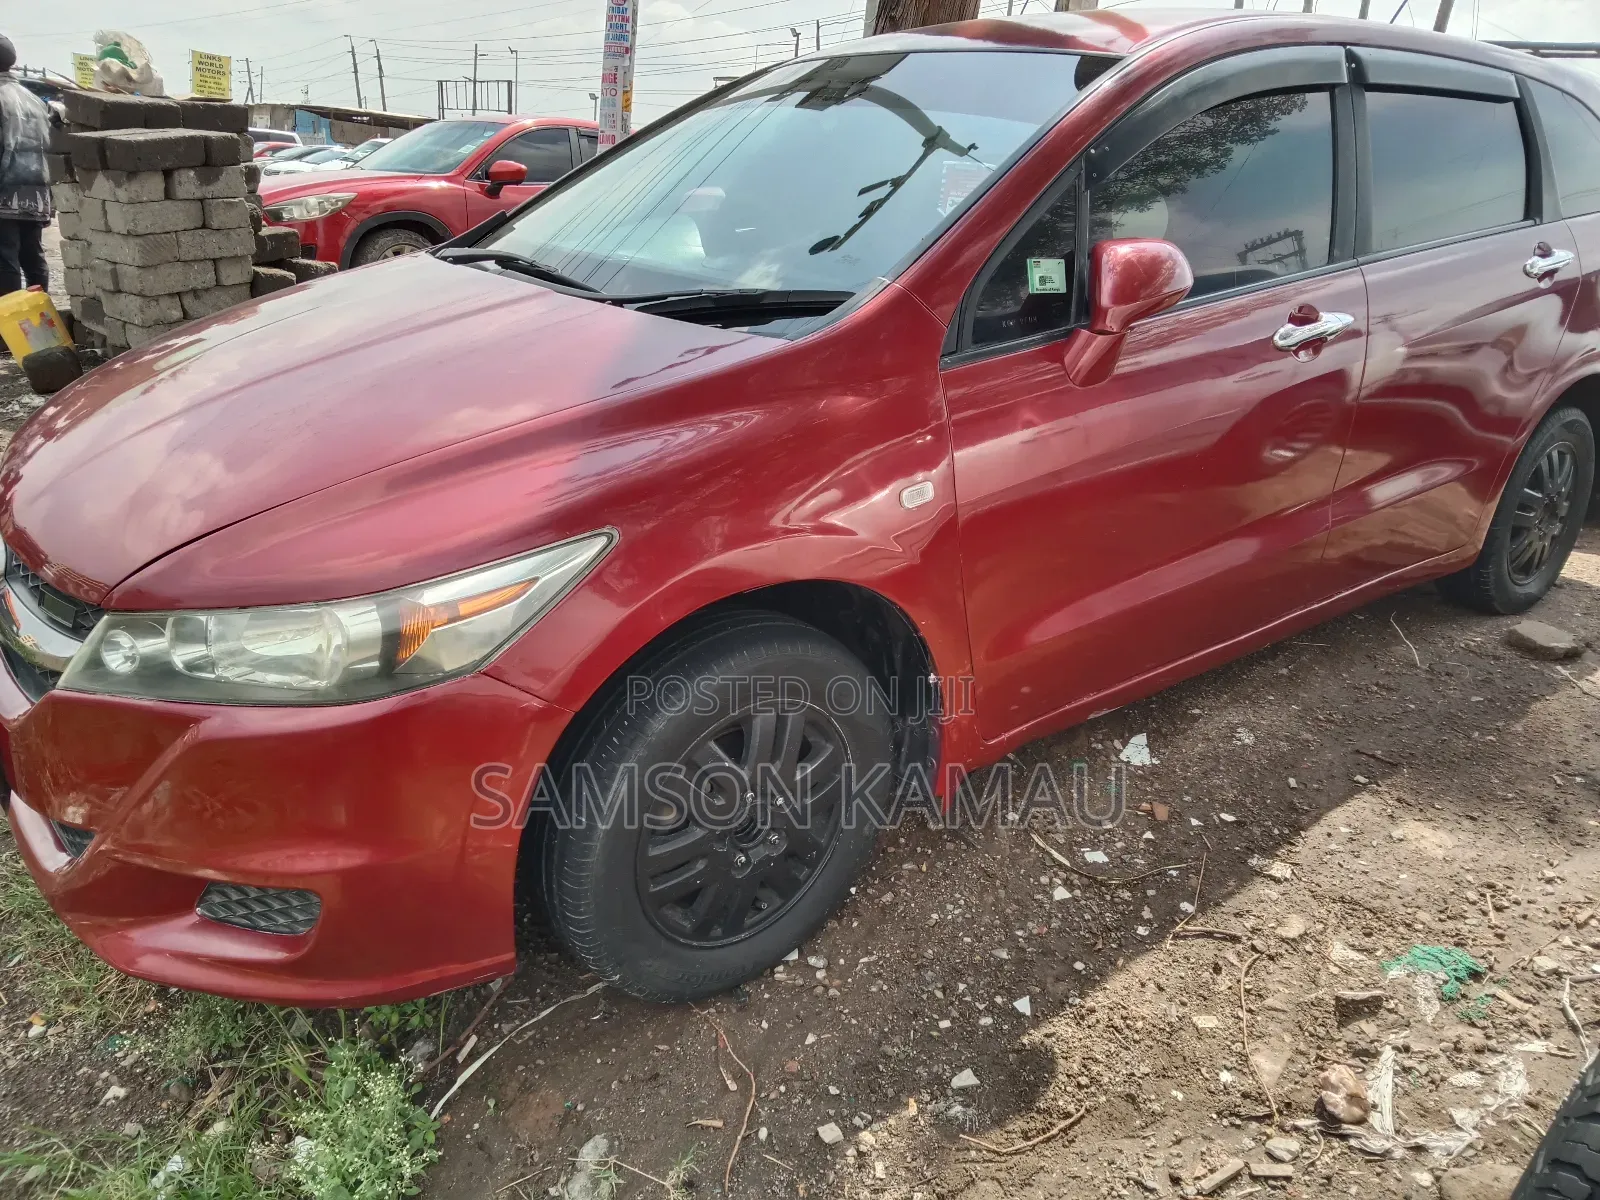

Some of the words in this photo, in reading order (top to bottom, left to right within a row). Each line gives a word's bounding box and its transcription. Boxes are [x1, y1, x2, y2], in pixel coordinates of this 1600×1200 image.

[609, 6, 628, 15] FRIDAY
[199, 54, 222, 62] LINKS
[197, 60, 224, 69] WORLD
[195, 66, 226, 76] MOTORS
